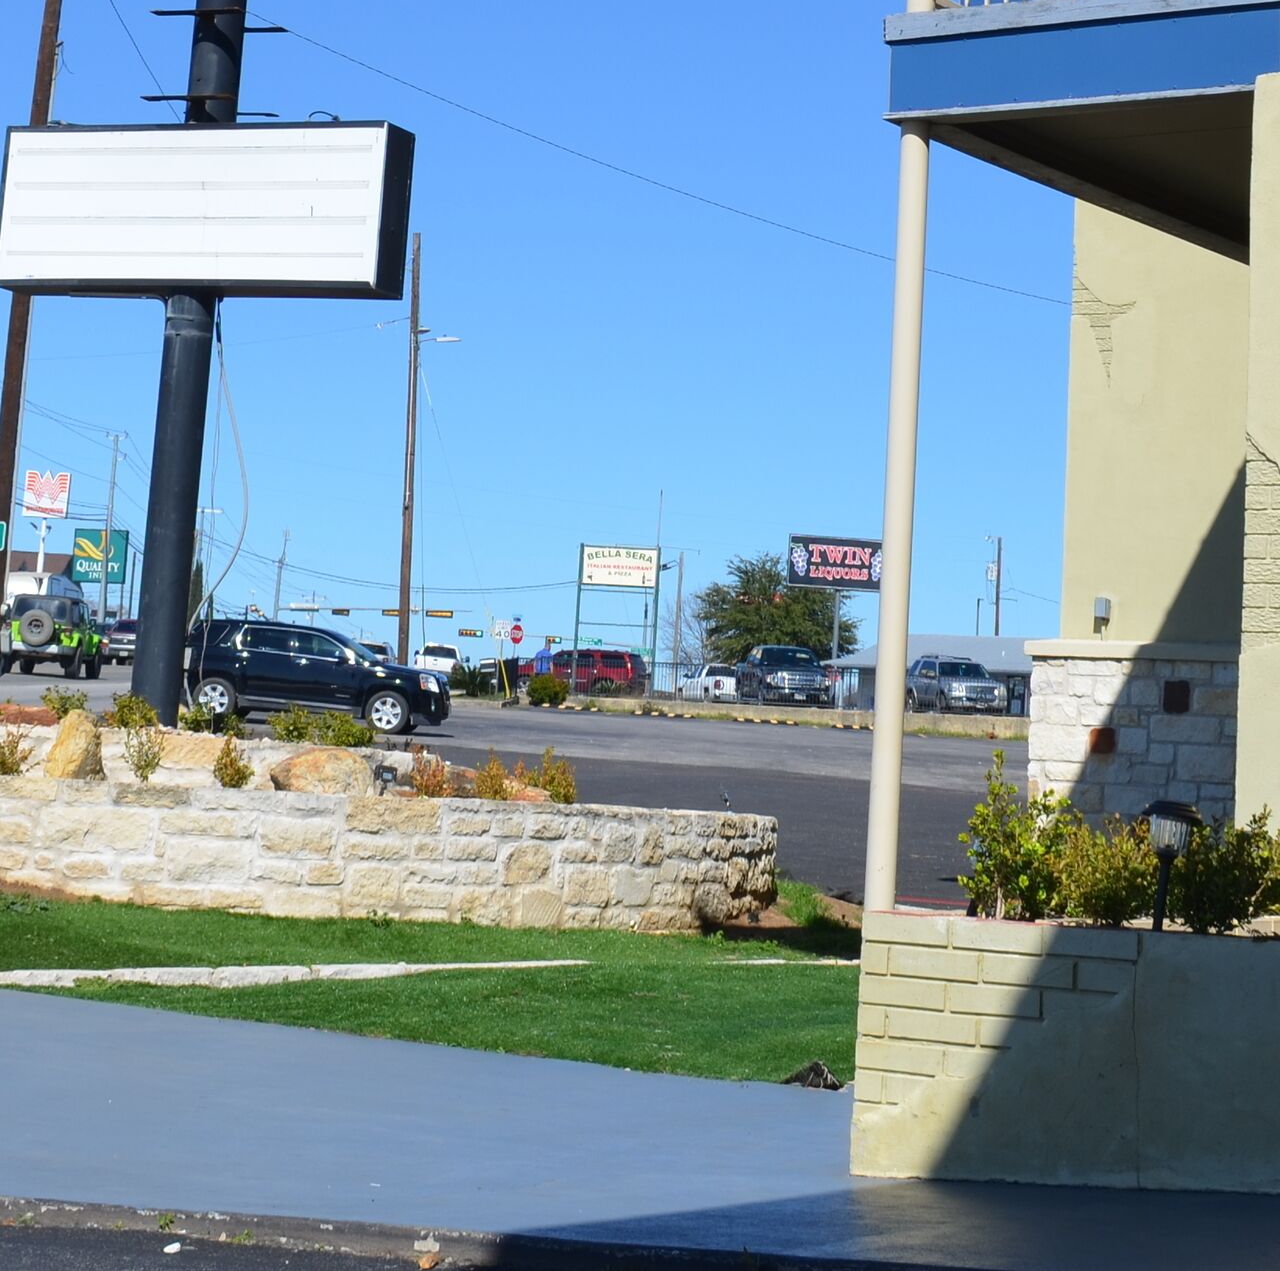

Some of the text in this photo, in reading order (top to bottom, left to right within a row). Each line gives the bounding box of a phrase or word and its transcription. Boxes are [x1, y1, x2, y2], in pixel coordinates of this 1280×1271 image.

[587, 550, 653, 564] BELLA SERA
[809, 543, 872, 566] TWIN
[76, 559, 120, 573] QUALTY
[809, 565, 869, 581] LIQUORS
